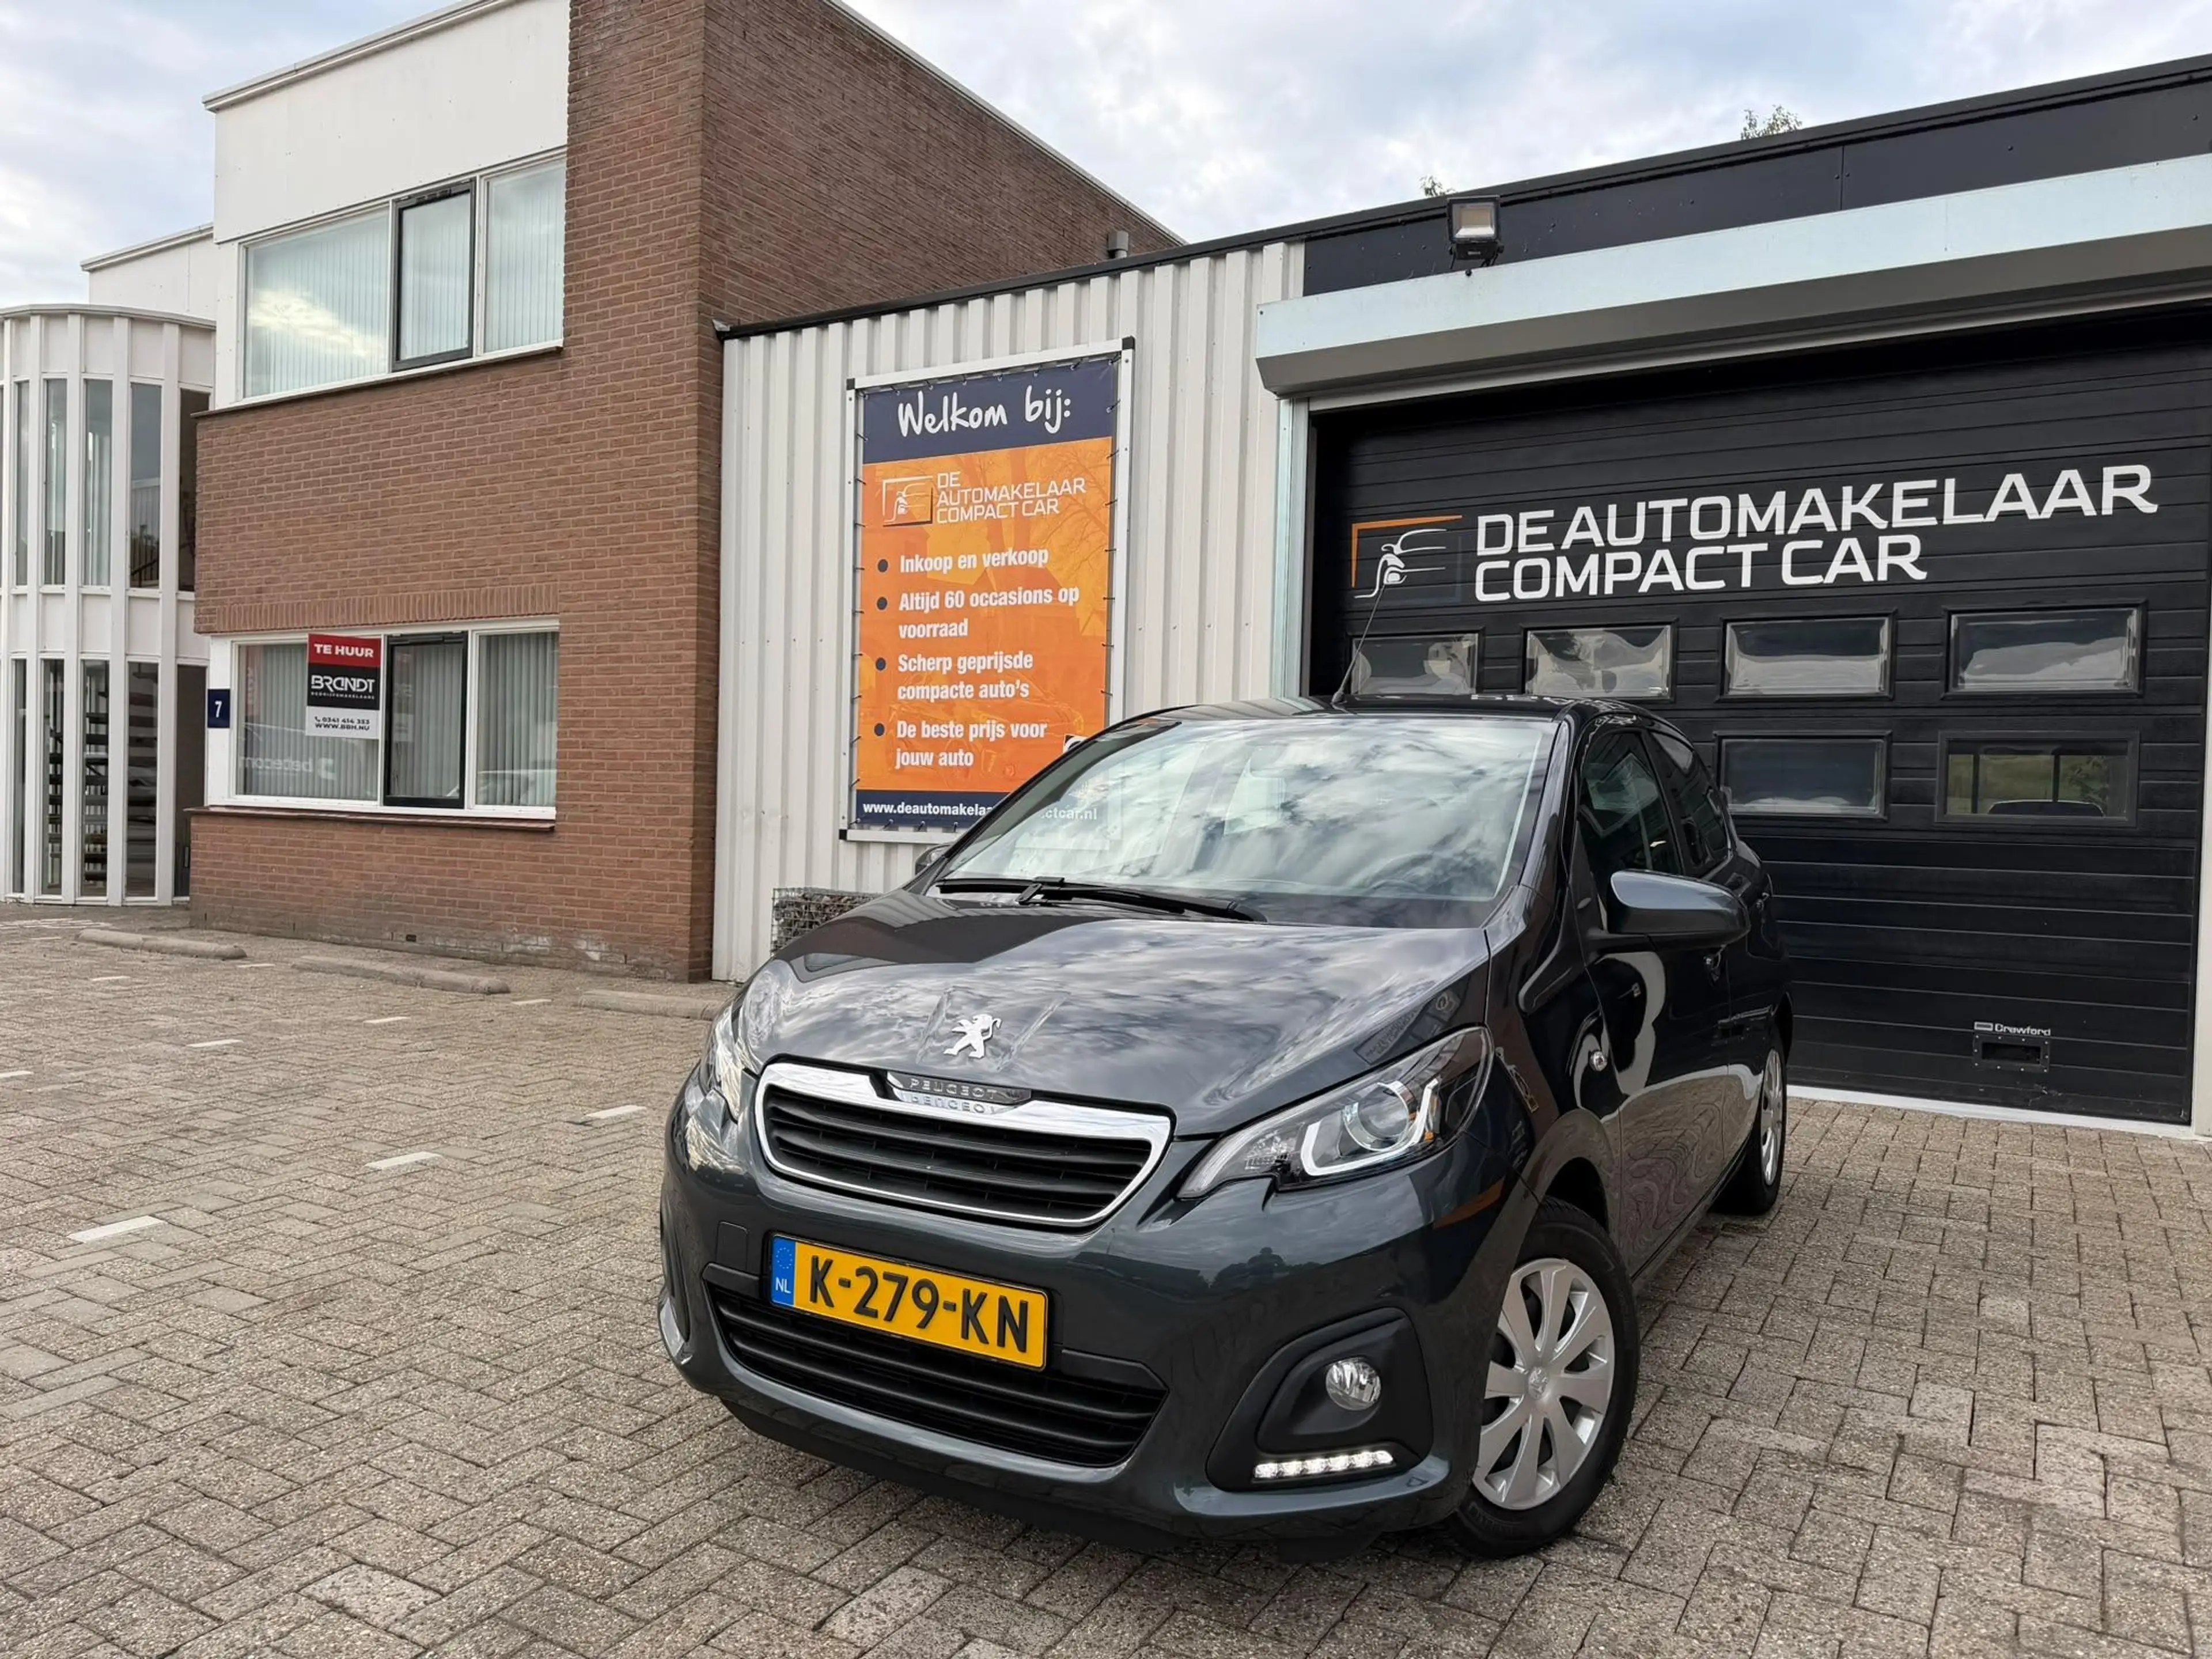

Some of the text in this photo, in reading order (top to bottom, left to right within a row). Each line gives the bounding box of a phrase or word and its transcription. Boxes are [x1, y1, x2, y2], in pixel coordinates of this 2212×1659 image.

[897, 385, 1071, 437] Welkom bij:
[937, 471, 961, 488] DE
[937, 478, 1086, 507] AUTOMAKELAAR
[937, 498, 1060, 524] COMPACT CAR
[1476, 464, 2158, 556] DE AUTOMAKELAAR
[900, 548, 1049, 574] Inkoop en verkoop
[1475, 534, 1927, 602] COMPACT CAR
[899, 586, 1080, 613] Altijd 60 occasions op
[899, 619, 969, 639] voorraad
[314, 643, 374, 658] TE HUUR
[897, 651, 1033, 675] Scherp geprijsde
[311, 675, 376, 693] BRANDT
[897, 680, 1030, 703] compacte auto's
[215, 700, 222, 718] 7
[896, 721, 1048, 742] De beste prijs voor
[895, 748, 974, 770] jouw auto
[1994, 1023, 2051, 1036] Crawford
[910, 1078, 998, 1100] PEUGEOT
[775, 1277, 791, 1294] NL
[809, 1255, 1029, 1353] K-279-KN
